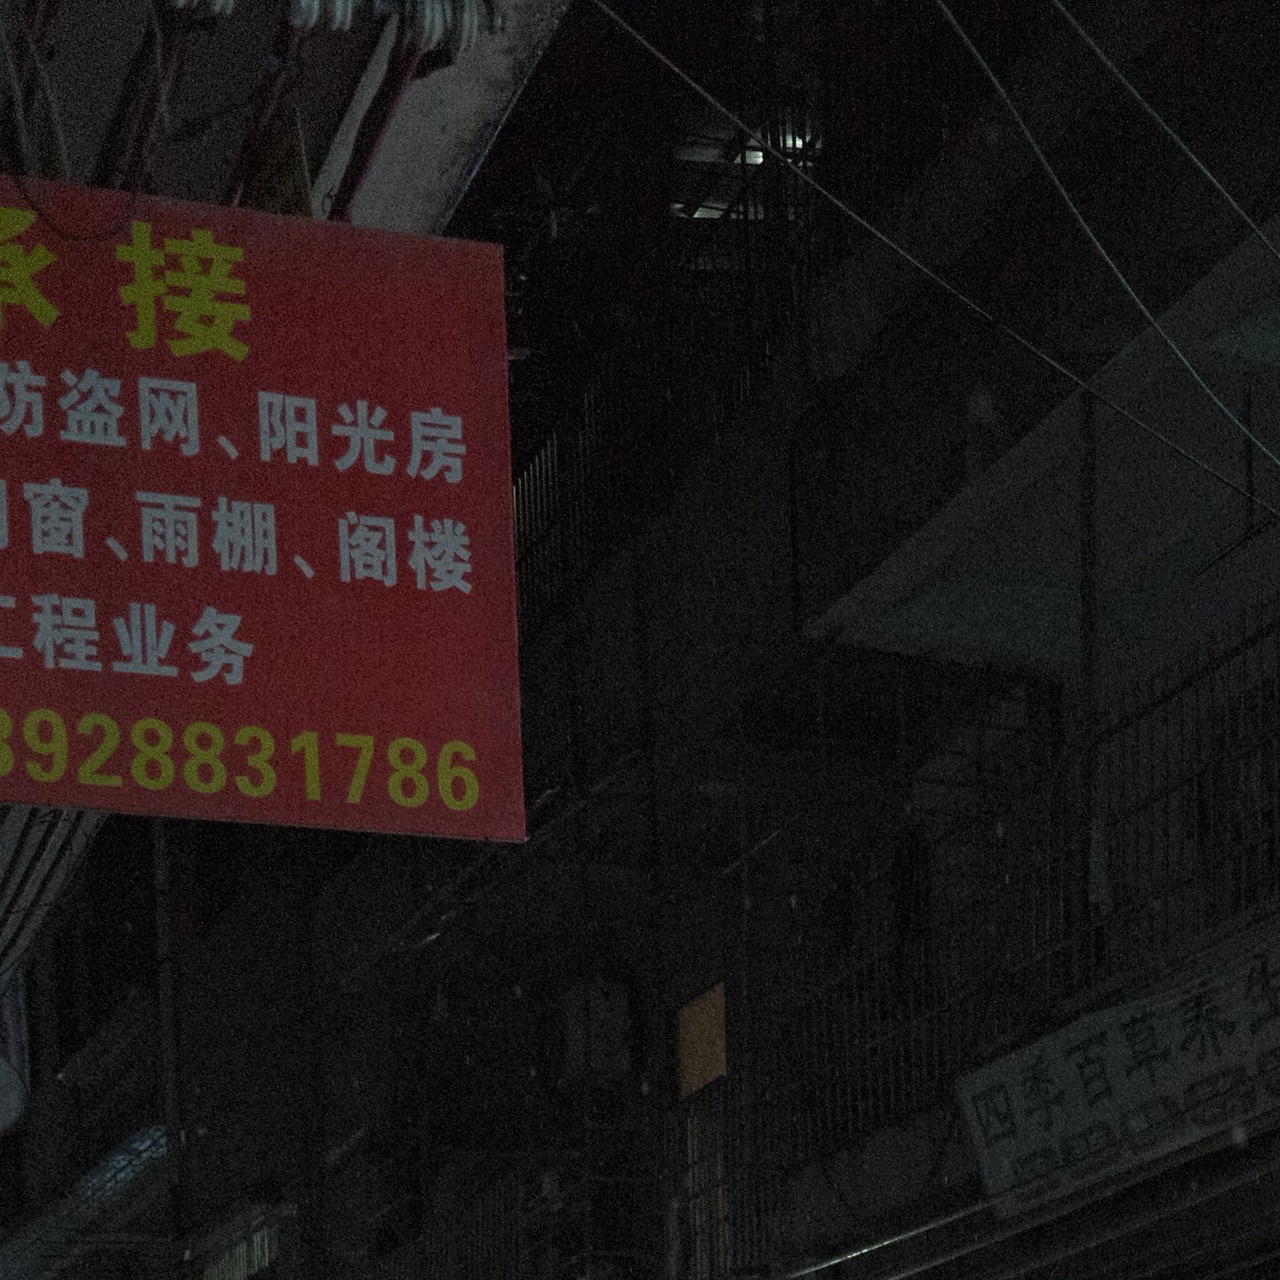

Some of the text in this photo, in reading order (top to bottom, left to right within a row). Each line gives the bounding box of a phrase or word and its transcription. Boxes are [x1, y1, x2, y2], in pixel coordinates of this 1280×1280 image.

[0, 478, 474, 596] 窗、雨棚、阁楼
